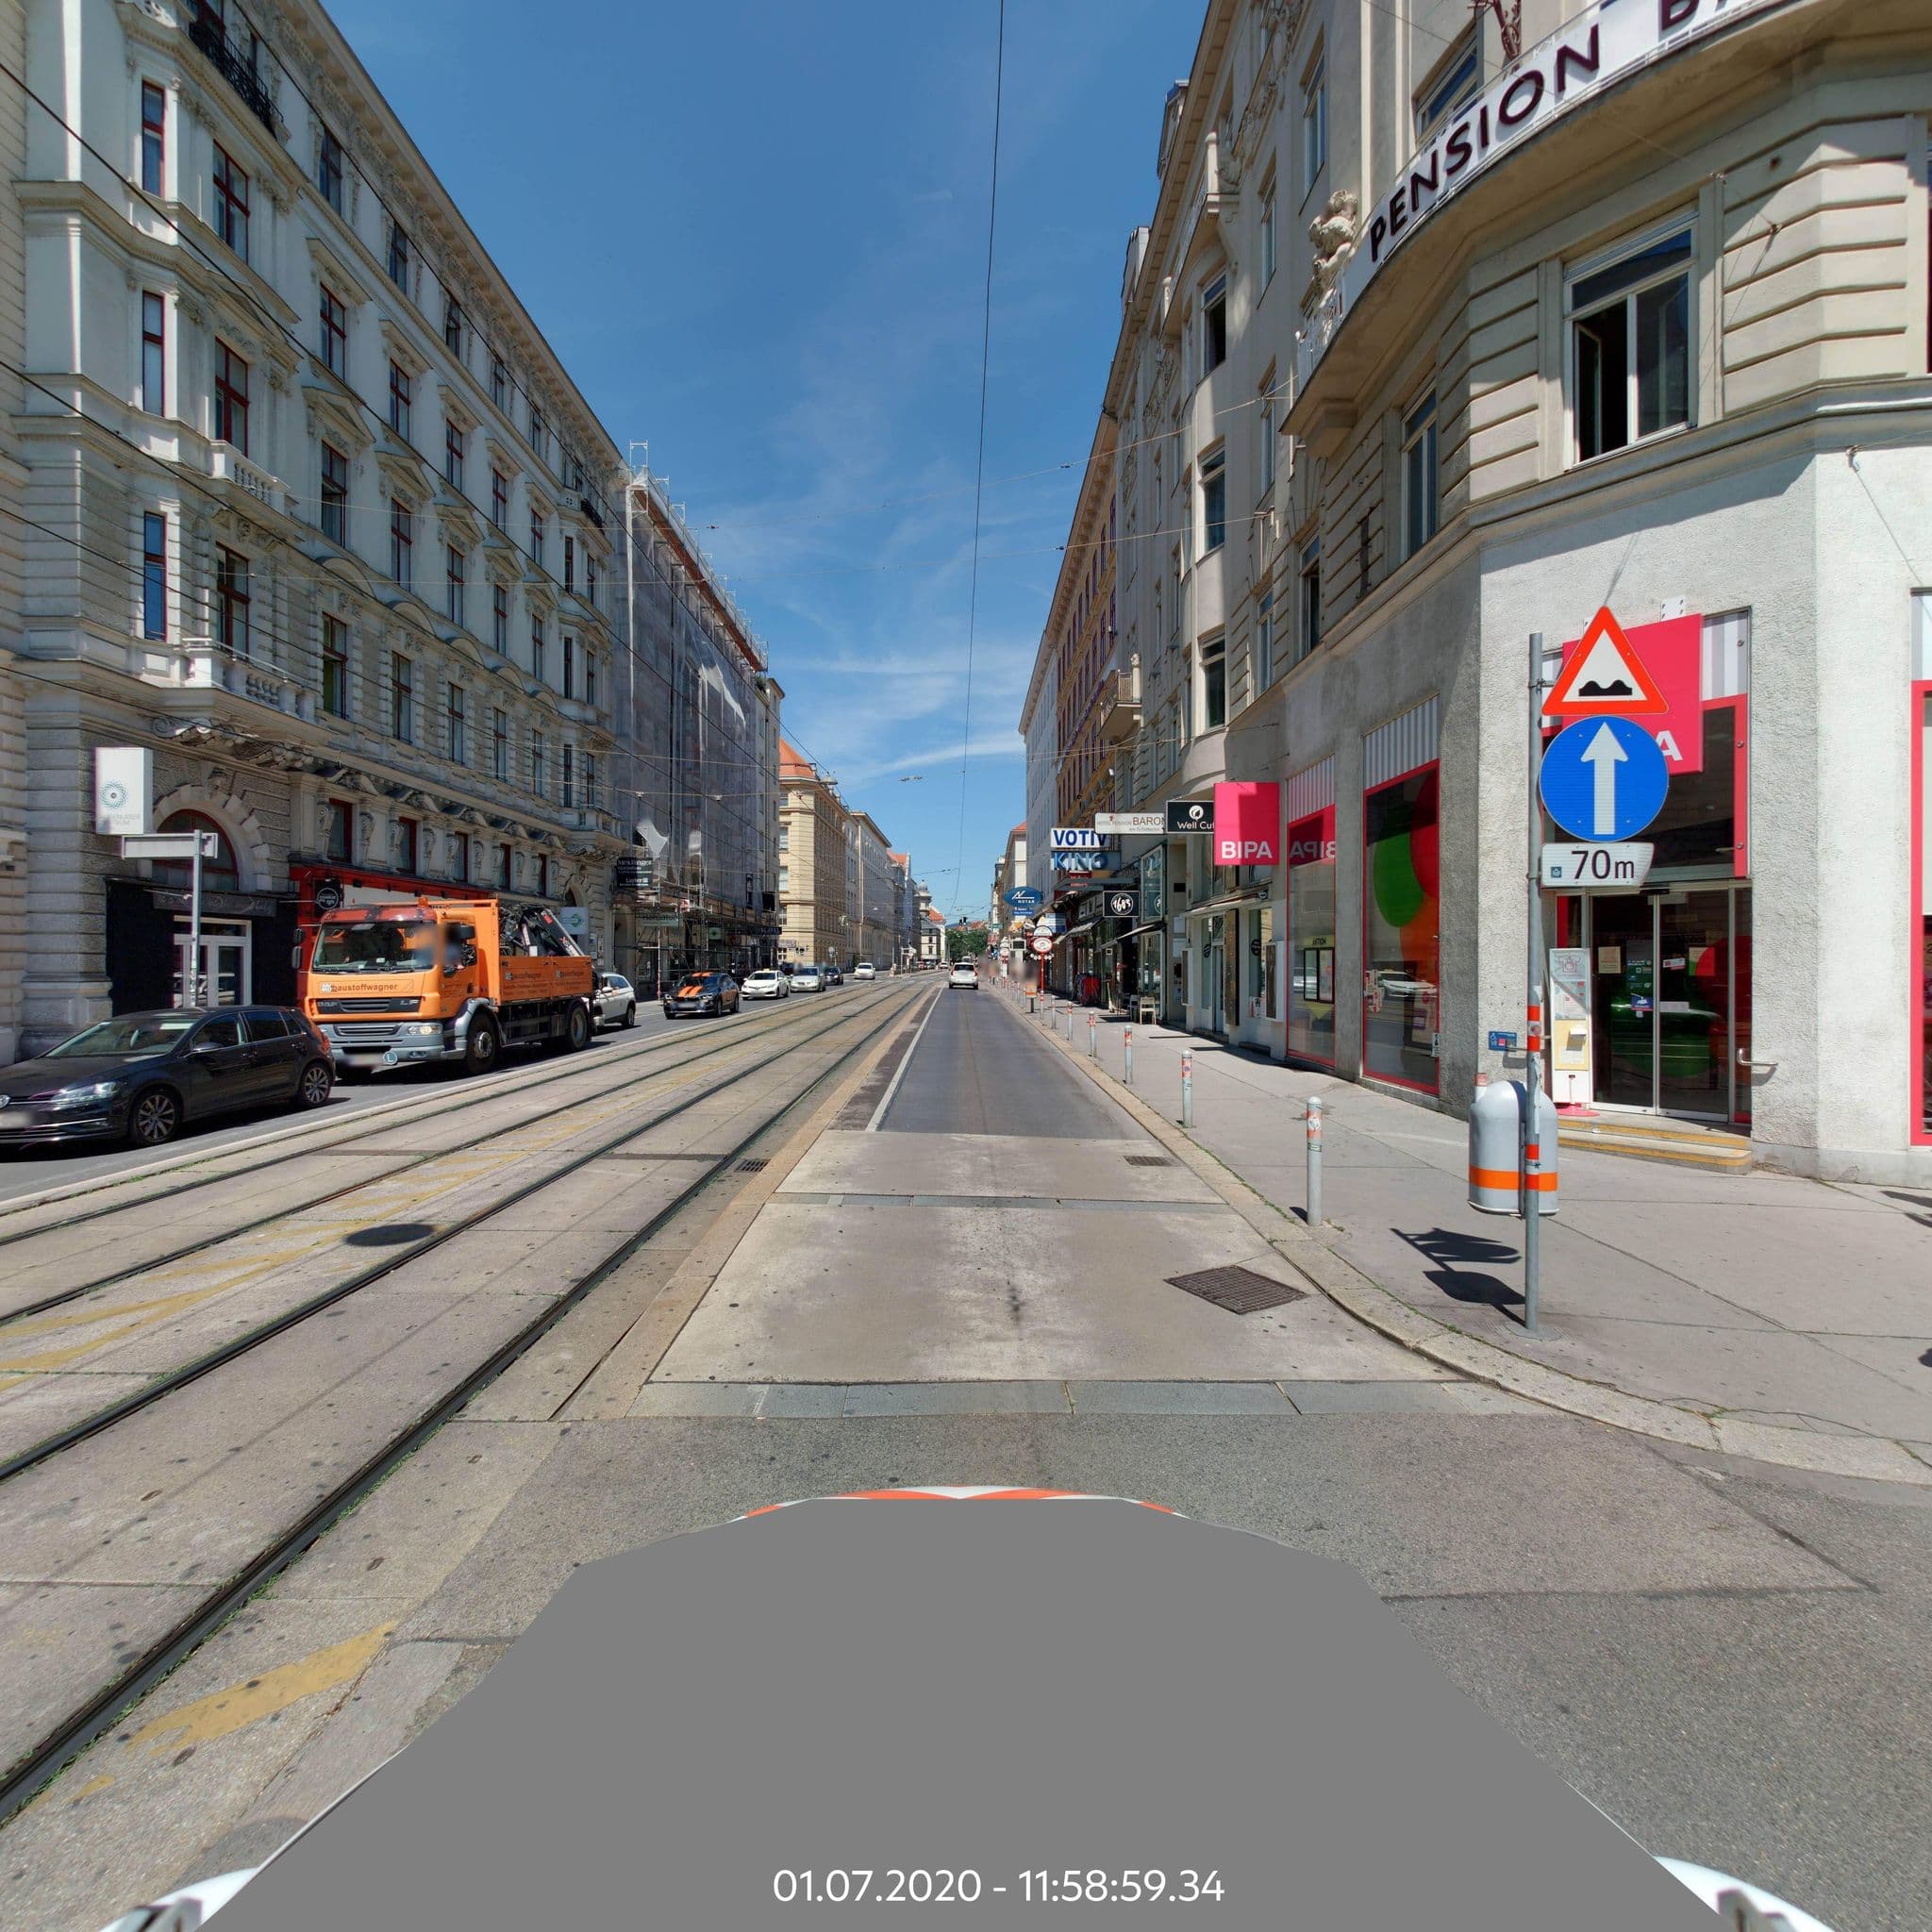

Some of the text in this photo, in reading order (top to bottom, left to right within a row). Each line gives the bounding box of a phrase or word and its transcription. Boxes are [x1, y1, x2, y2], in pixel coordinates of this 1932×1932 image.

[1371, 23, 1600, 262] PENSION
[1177, 821, 1196, 829] Well
[1053, 830, 1107, 846] VOTIV
[1221, 841, 1273, 859] BIPA
[1572, 850, 1635, 879] 70m
